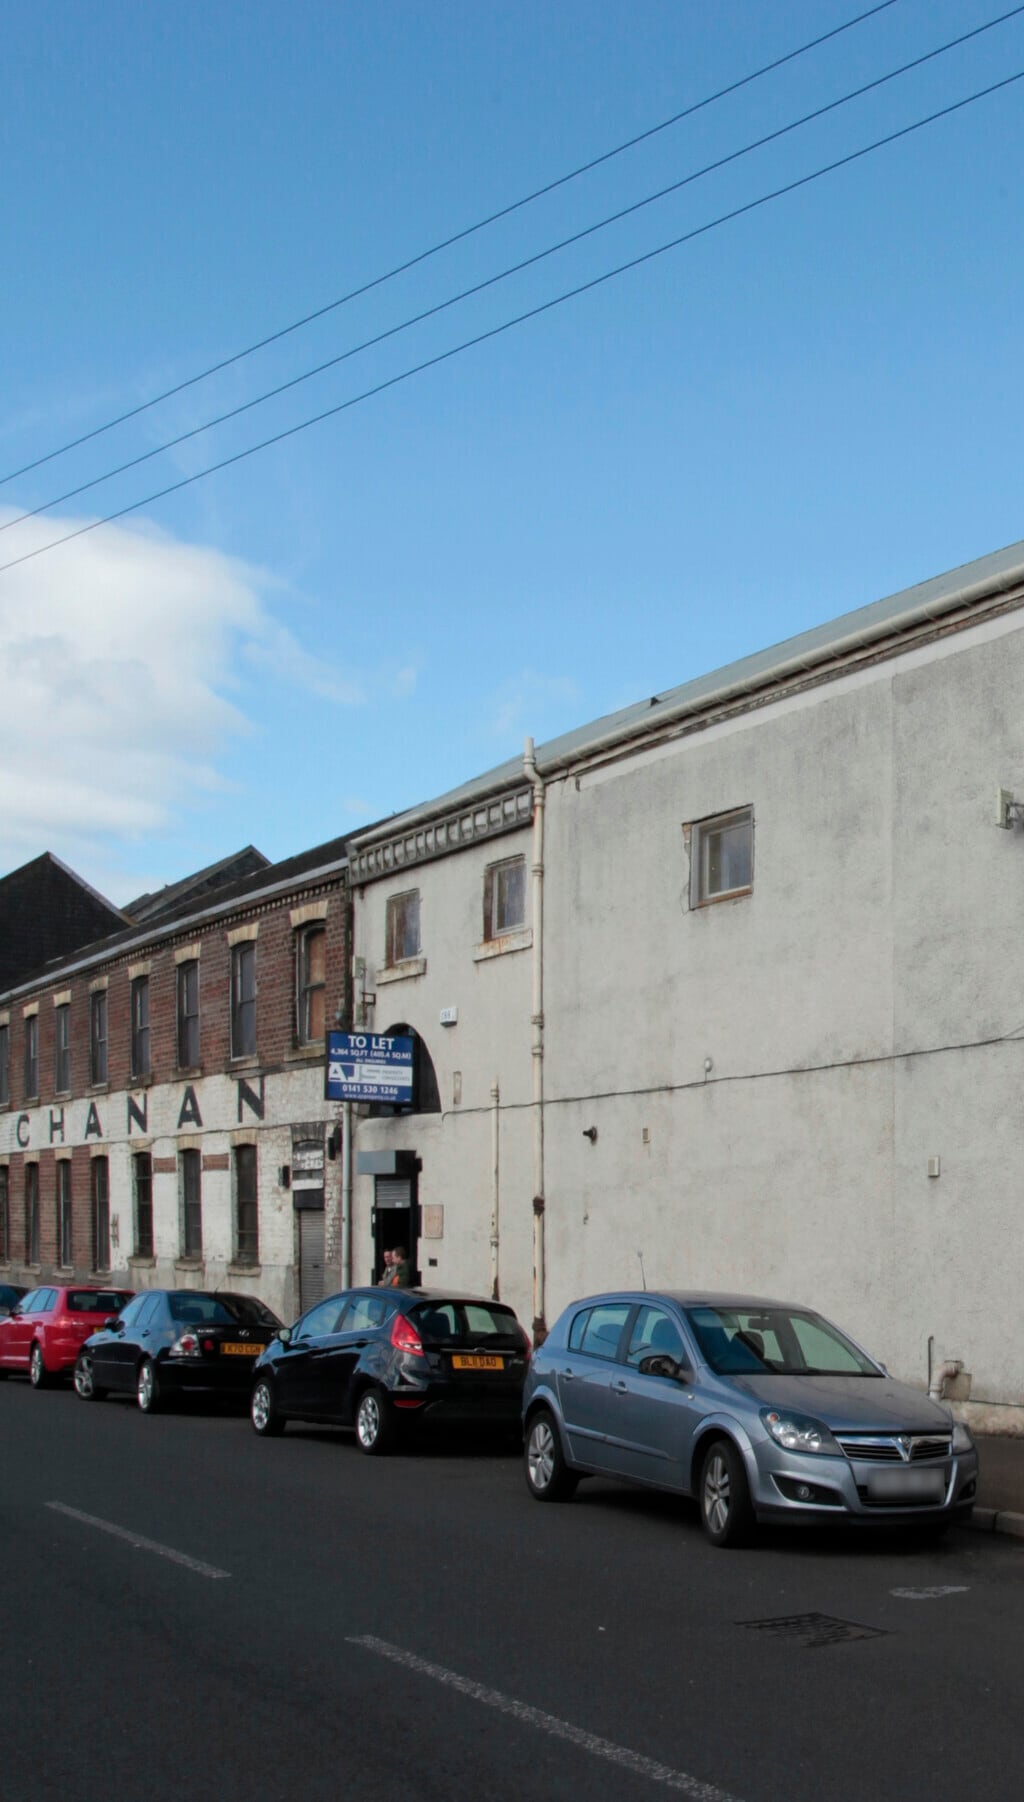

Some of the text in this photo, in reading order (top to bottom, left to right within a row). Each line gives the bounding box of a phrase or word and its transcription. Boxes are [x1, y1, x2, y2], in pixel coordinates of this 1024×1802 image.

[348, 1035, 395, 1050] TO LET
[342, 1084, 360, 1092] 0141
[380, 1086, 398, 1095] 1246
